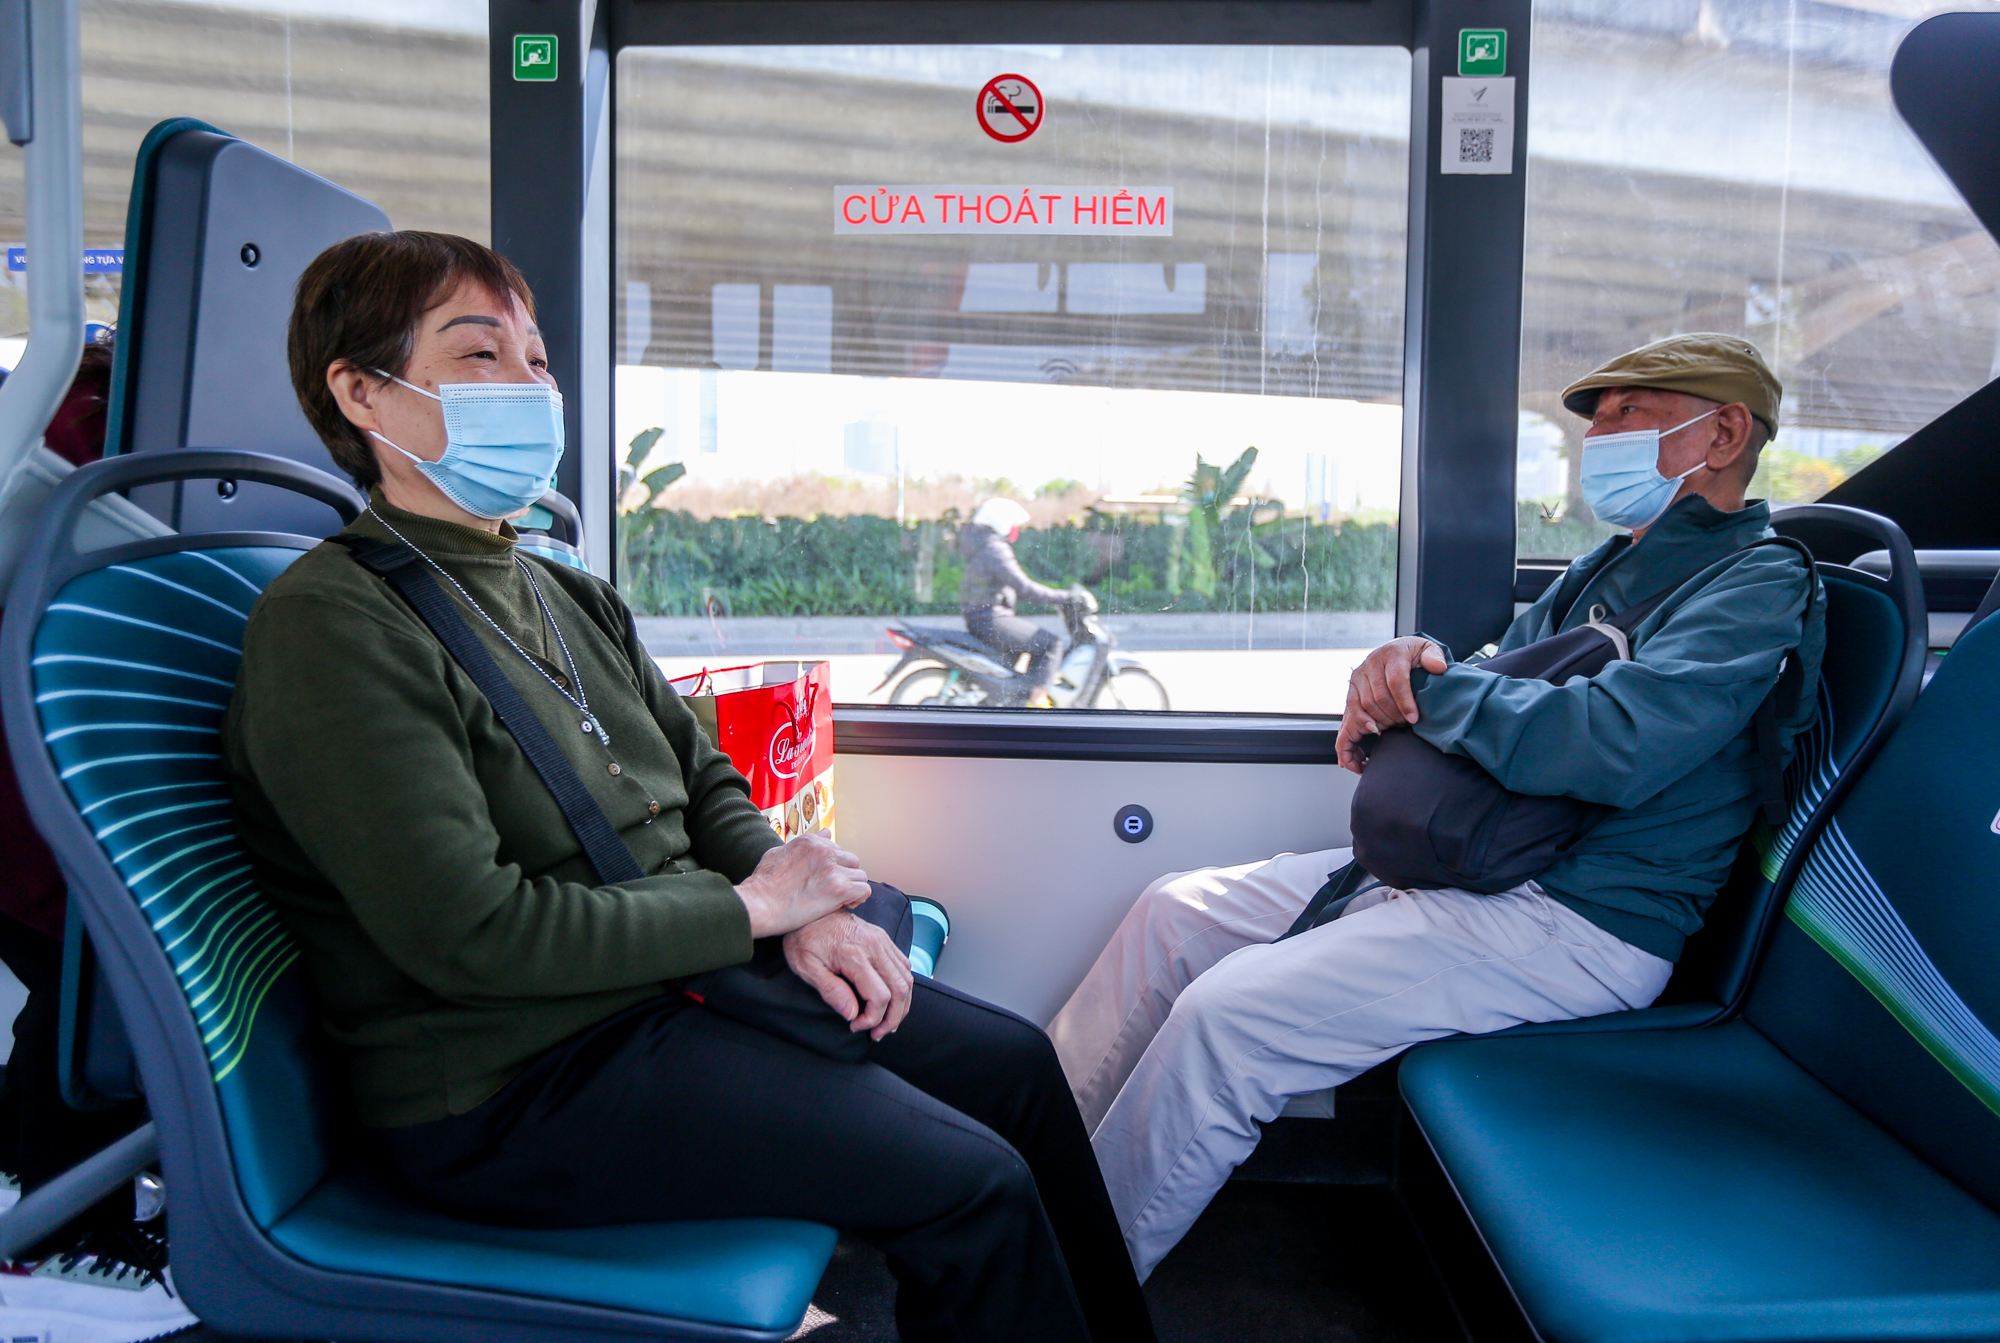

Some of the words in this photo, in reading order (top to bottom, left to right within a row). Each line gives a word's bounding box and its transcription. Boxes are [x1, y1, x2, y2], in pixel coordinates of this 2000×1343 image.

[842, 187, 926, 225] CỬA
[934, 188, 1062, 225] THOÁT
[1074, 189, 1166, 226] HIỂM
